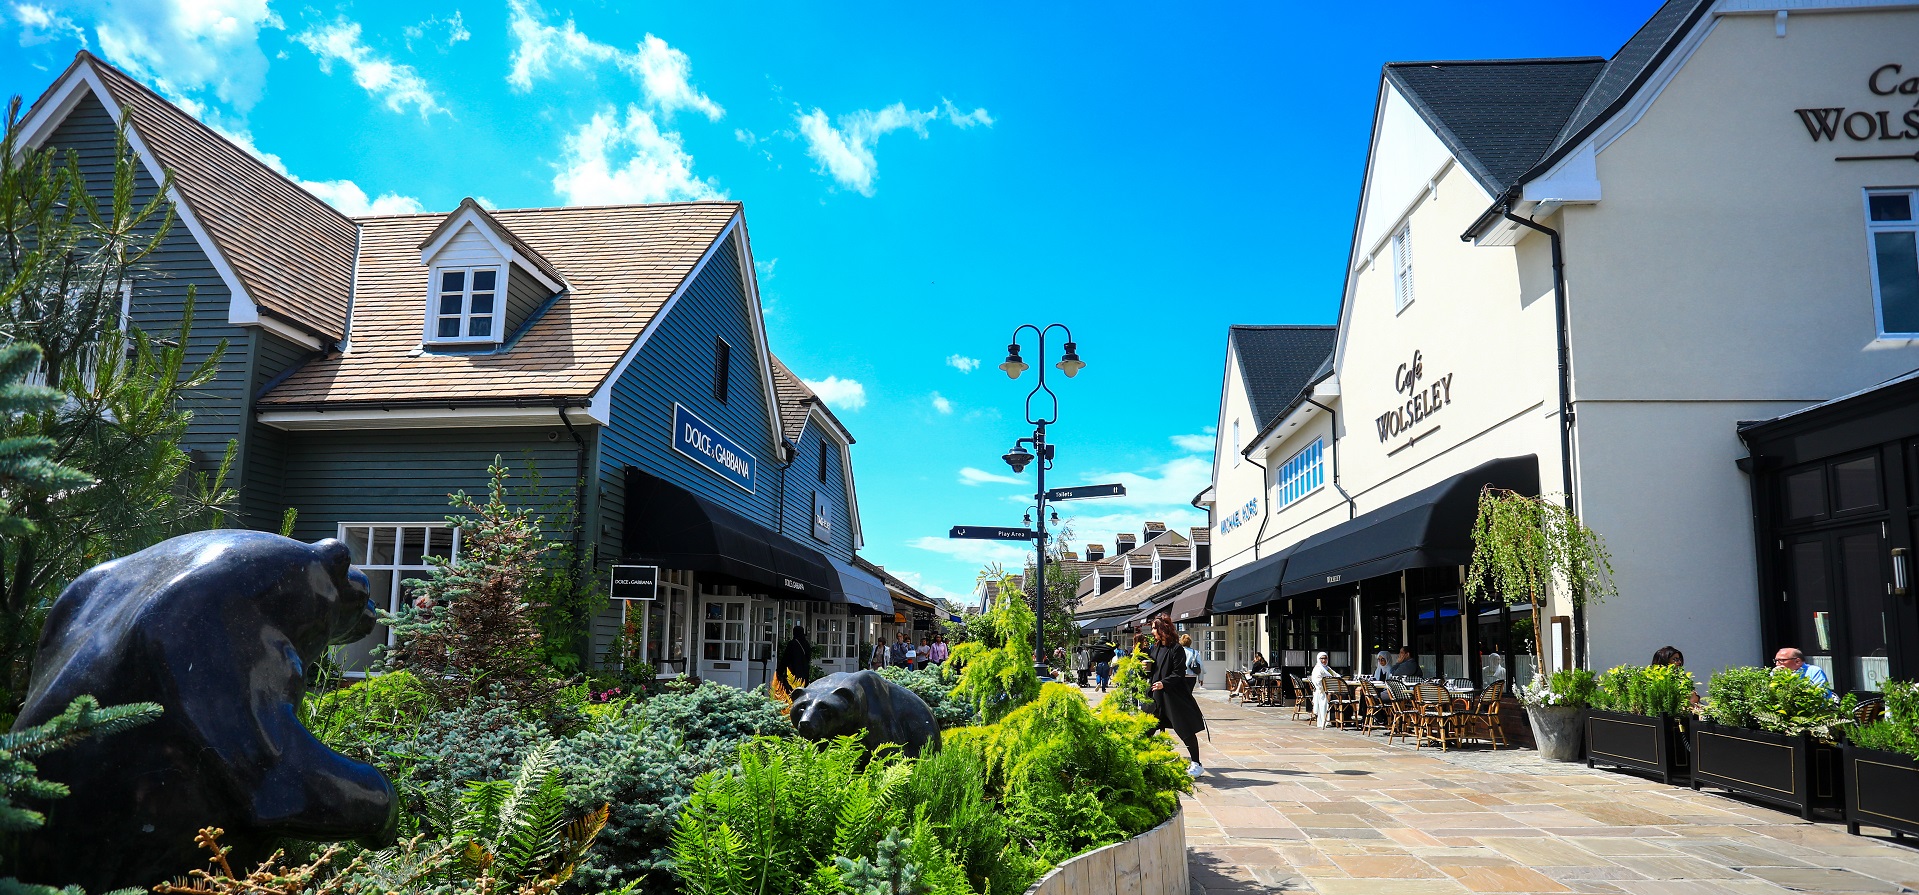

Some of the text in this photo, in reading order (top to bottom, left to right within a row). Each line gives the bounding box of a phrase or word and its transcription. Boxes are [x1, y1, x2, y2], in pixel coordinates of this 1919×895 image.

[1868, 63, 1919, 108] Ca
[1396, 349, 1422, 397] Café
[1375, 372, 1453, 444] WOLSELEY
[684, 422, 712, 457] DOLCE
[715, 443, 750, 480] GABBANA
[998, 530, 1010, 538] Play
